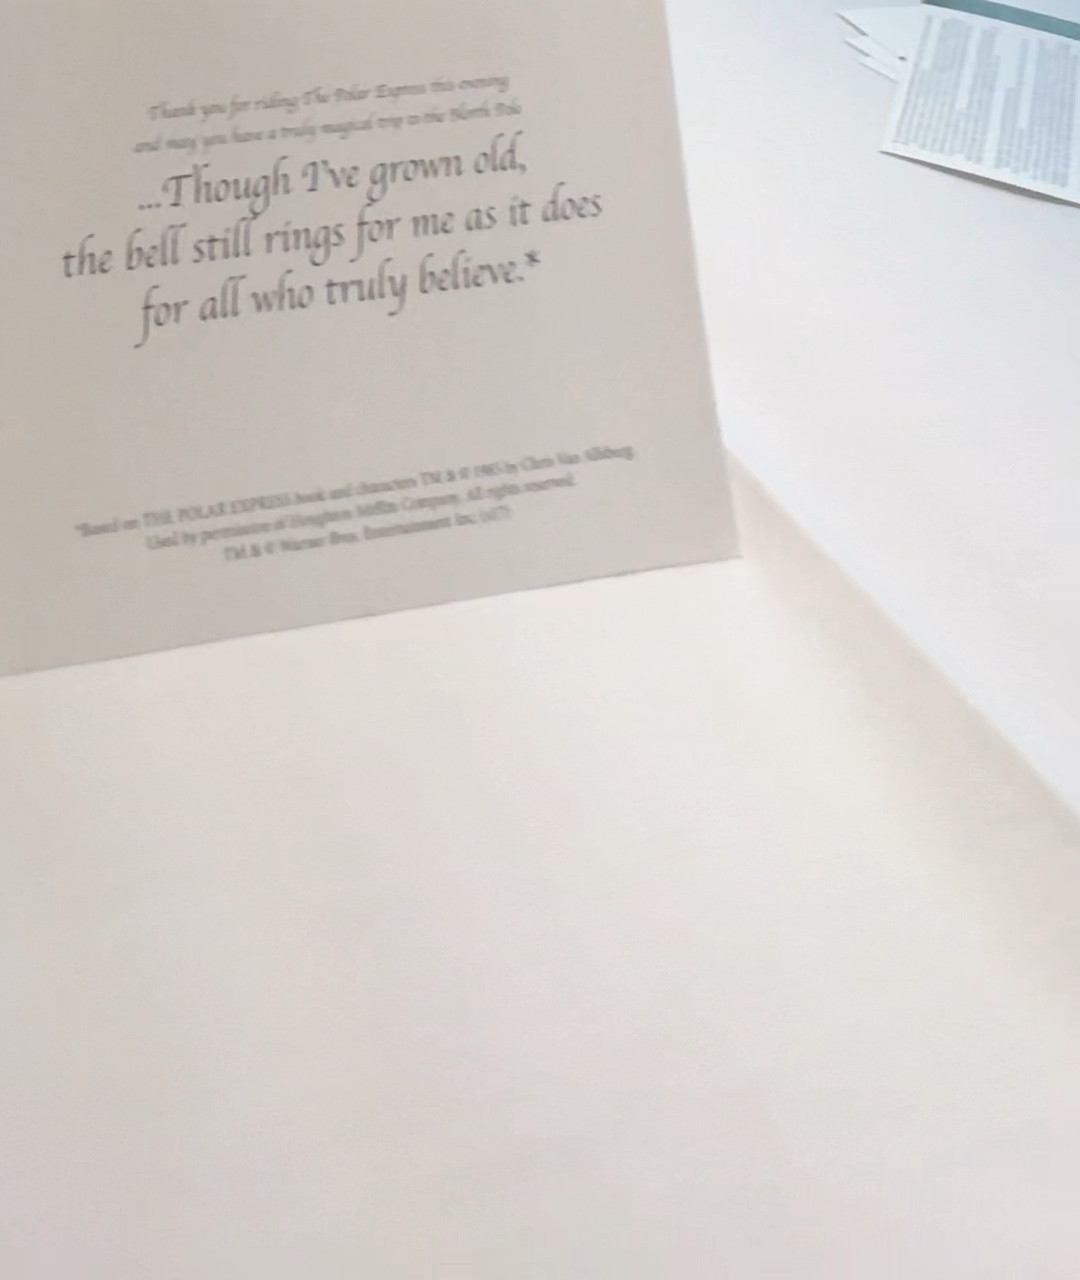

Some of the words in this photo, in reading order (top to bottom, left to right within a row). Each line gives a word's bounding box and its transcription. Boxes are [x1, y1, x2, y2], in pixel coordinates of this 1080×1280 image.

[301, 158, 360, 193] I've
[366, 155, 464, 203] grown
[473, 130, 528, 175] old,
[62, 233, 113, 278] the
[125, 222, 188, 271] bell
[192, 216, 256, 264] still
[265, 220, 346, 267] rings
[348, 202, 402, 263] for
[411, 211, 455, 238] me
[464, 205, 497, 232] as
[508, 195, 532, 227] it
[541, 181, 603, 223] does
[133, 284, 190, 349] for
[199, 274, 247, 323] all
[250, 268, 315, 313] who
[325, 257, 408, 317] truly
